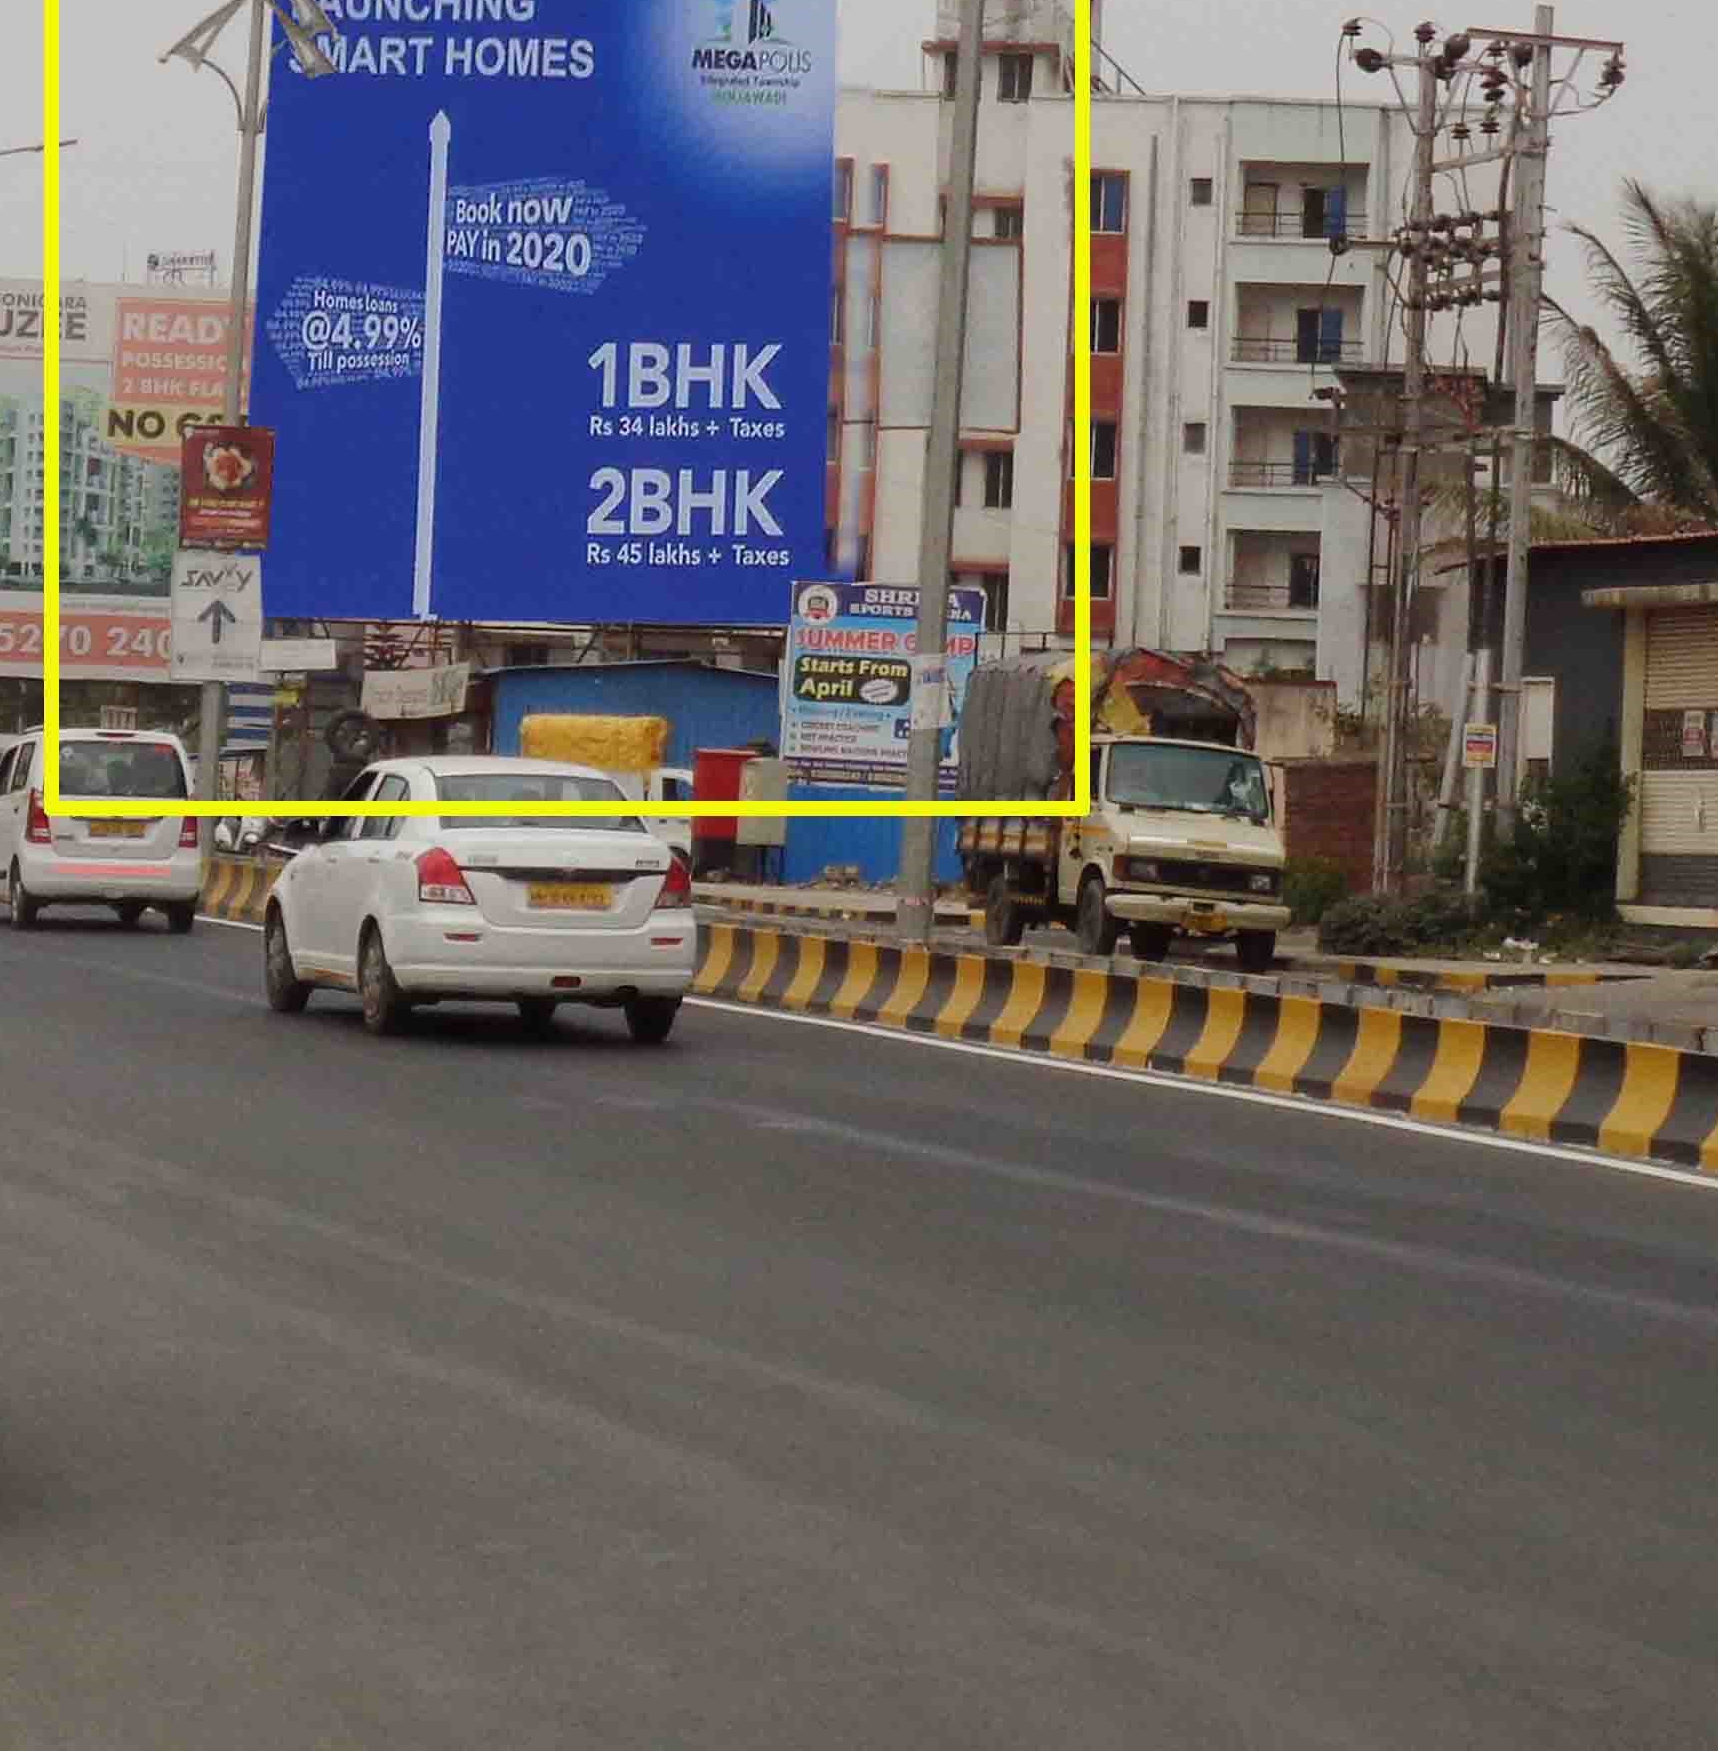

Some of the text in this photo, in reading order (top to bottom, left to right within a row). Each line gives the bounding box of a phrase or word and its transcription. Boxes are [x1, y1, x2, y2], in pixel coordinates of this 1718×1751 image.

[445, 36, 595, 78] HOMES
[691, 48, 812, 74] MEGAPOLIS
[456, 193, 574, 225] Book now
[446, 230, 593, 277] PAY in 2020
[314, 290, 399, 314] Homes loans
[122, 313, 231, 345] READ
[302, 311, 422, 351] @4.99%
[307, 350, 410, 374] Till possession
[123, 379, 132, 394] 2
[140, 379, 180, 396] BHK
[587, 342, 783, 409] 1BHK
[106, 409, 166, 440] NO
[589, 415, 613, 436] Rs
[618, 416, 644, 436] 34
[649, 415, 700, 438] lakhs
[730, 417, 786, 439] Taxes
[586, 466, 784, 537] 2BHK
[587, 543, 611, 564] Rs
[616, 543, 643, 565] 45
[648, 542, 701, 566] lakhs
[732, 544, 791, 566] Taxes
[849, 603, 914, 617] SPORTS
[796, 628, 897, 651] SUMMER
[800, 656, 908, 678] Starts From
[799, 677, 853, 700] April
